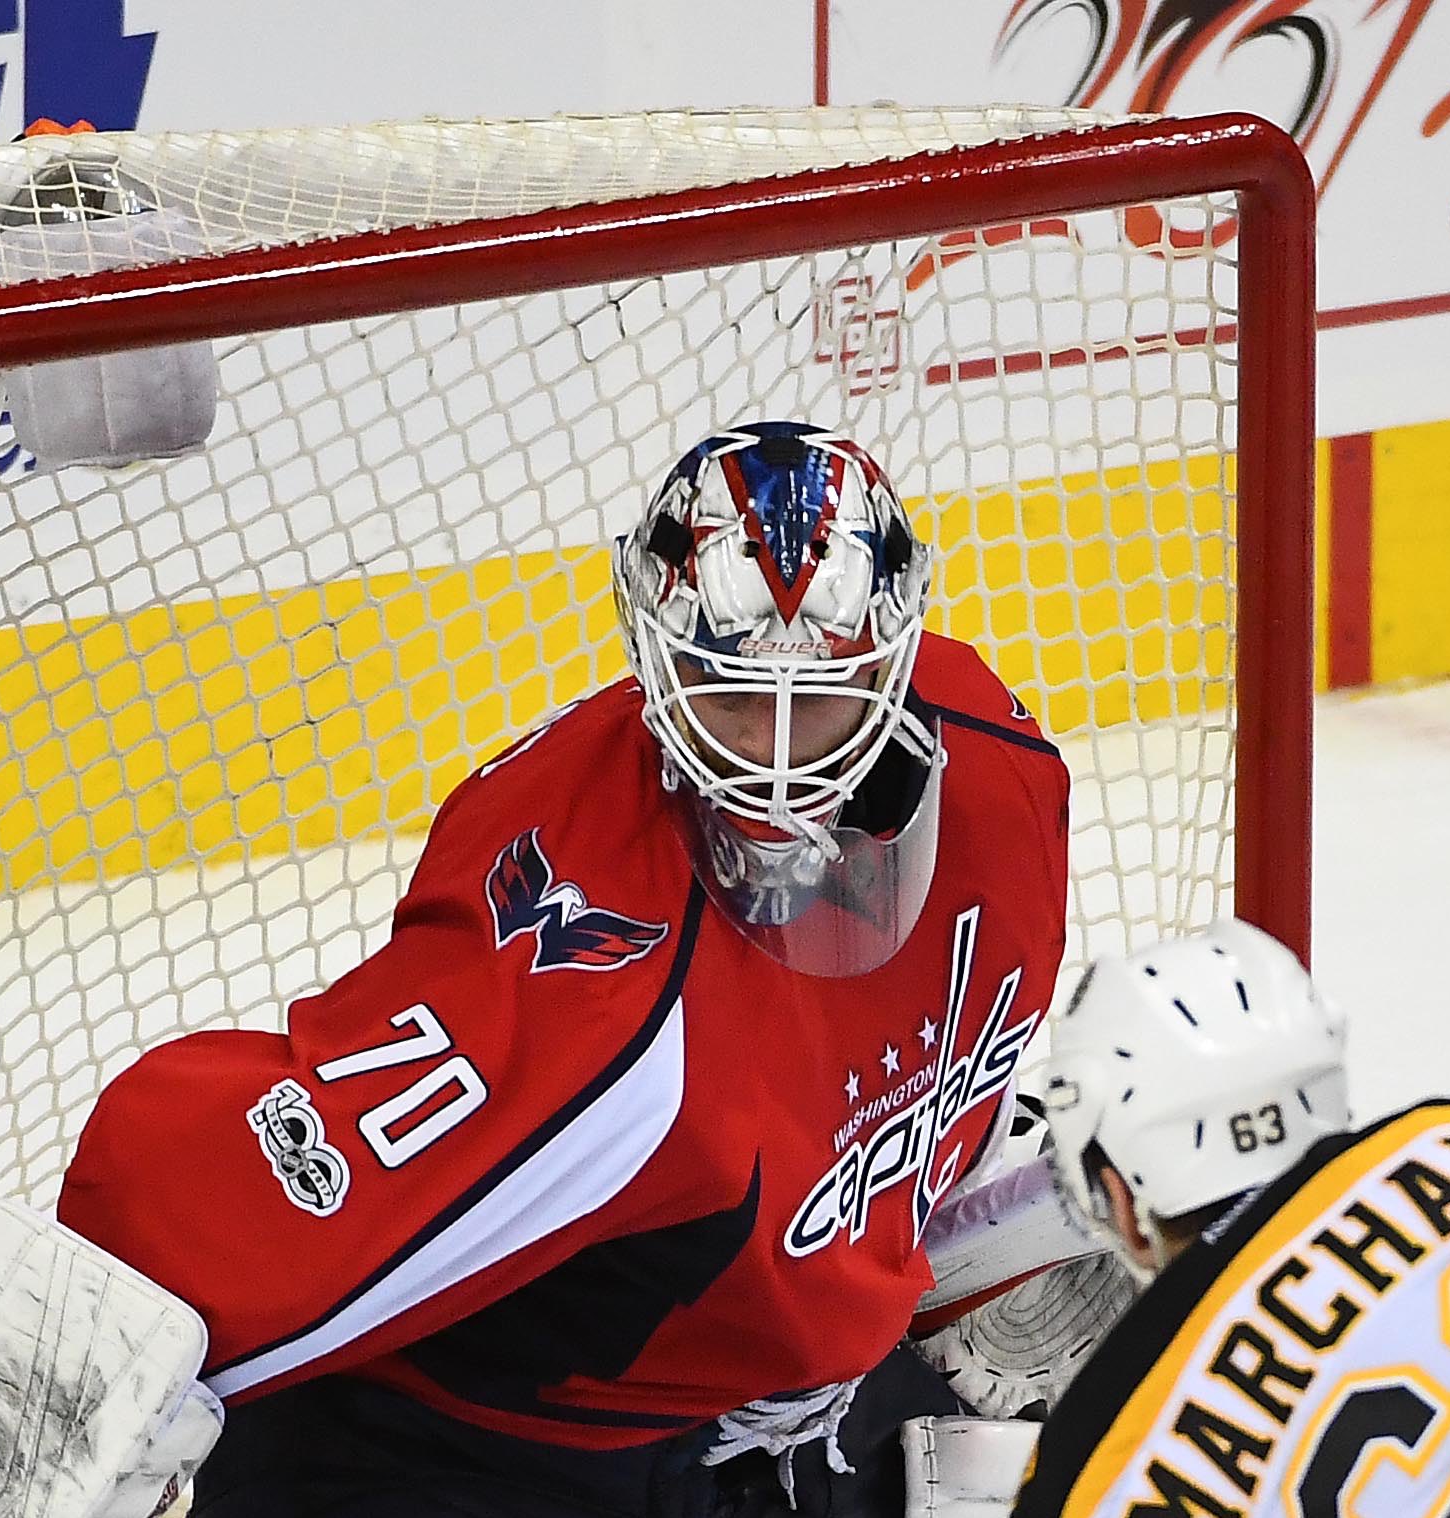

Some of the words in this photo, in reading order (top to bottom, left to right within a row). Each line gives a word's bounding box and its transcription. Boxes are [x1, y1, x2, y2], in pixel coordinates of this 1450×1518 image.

[315, 1003, 489, 1169] 70
[833, 1059, 937, 1153] WASHINGTON
[1229, 1103, 1288, 1155] 63
